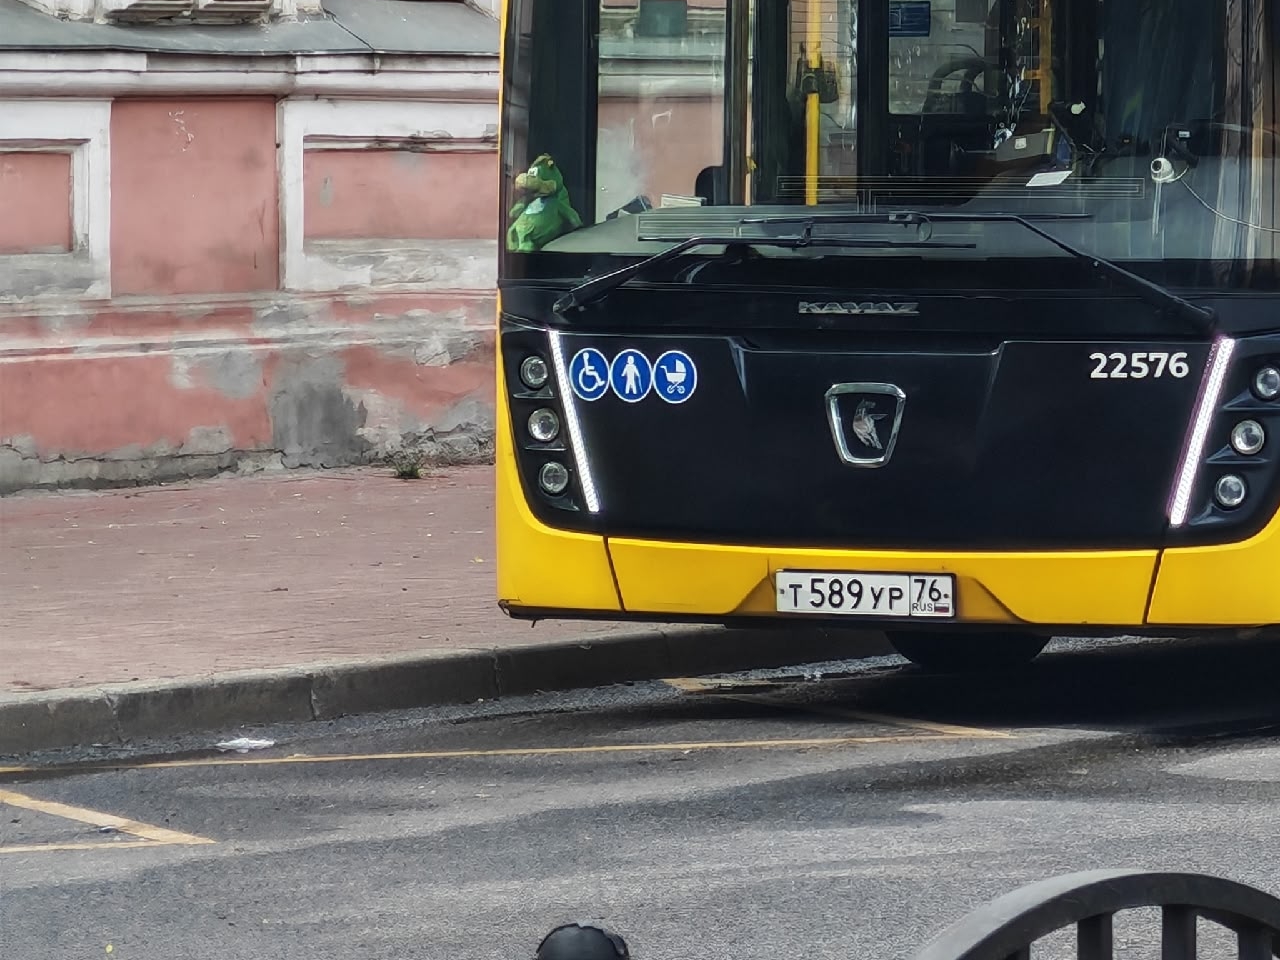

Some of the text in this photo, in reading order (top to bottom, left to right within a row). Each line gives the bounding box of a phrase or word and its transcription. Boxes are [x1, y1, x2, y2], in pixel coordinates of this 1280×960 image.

[1089, 351, 1191, 380] 22576
[913, 578, 942, 603] 76
[911, 602, 934, 612] RUS
